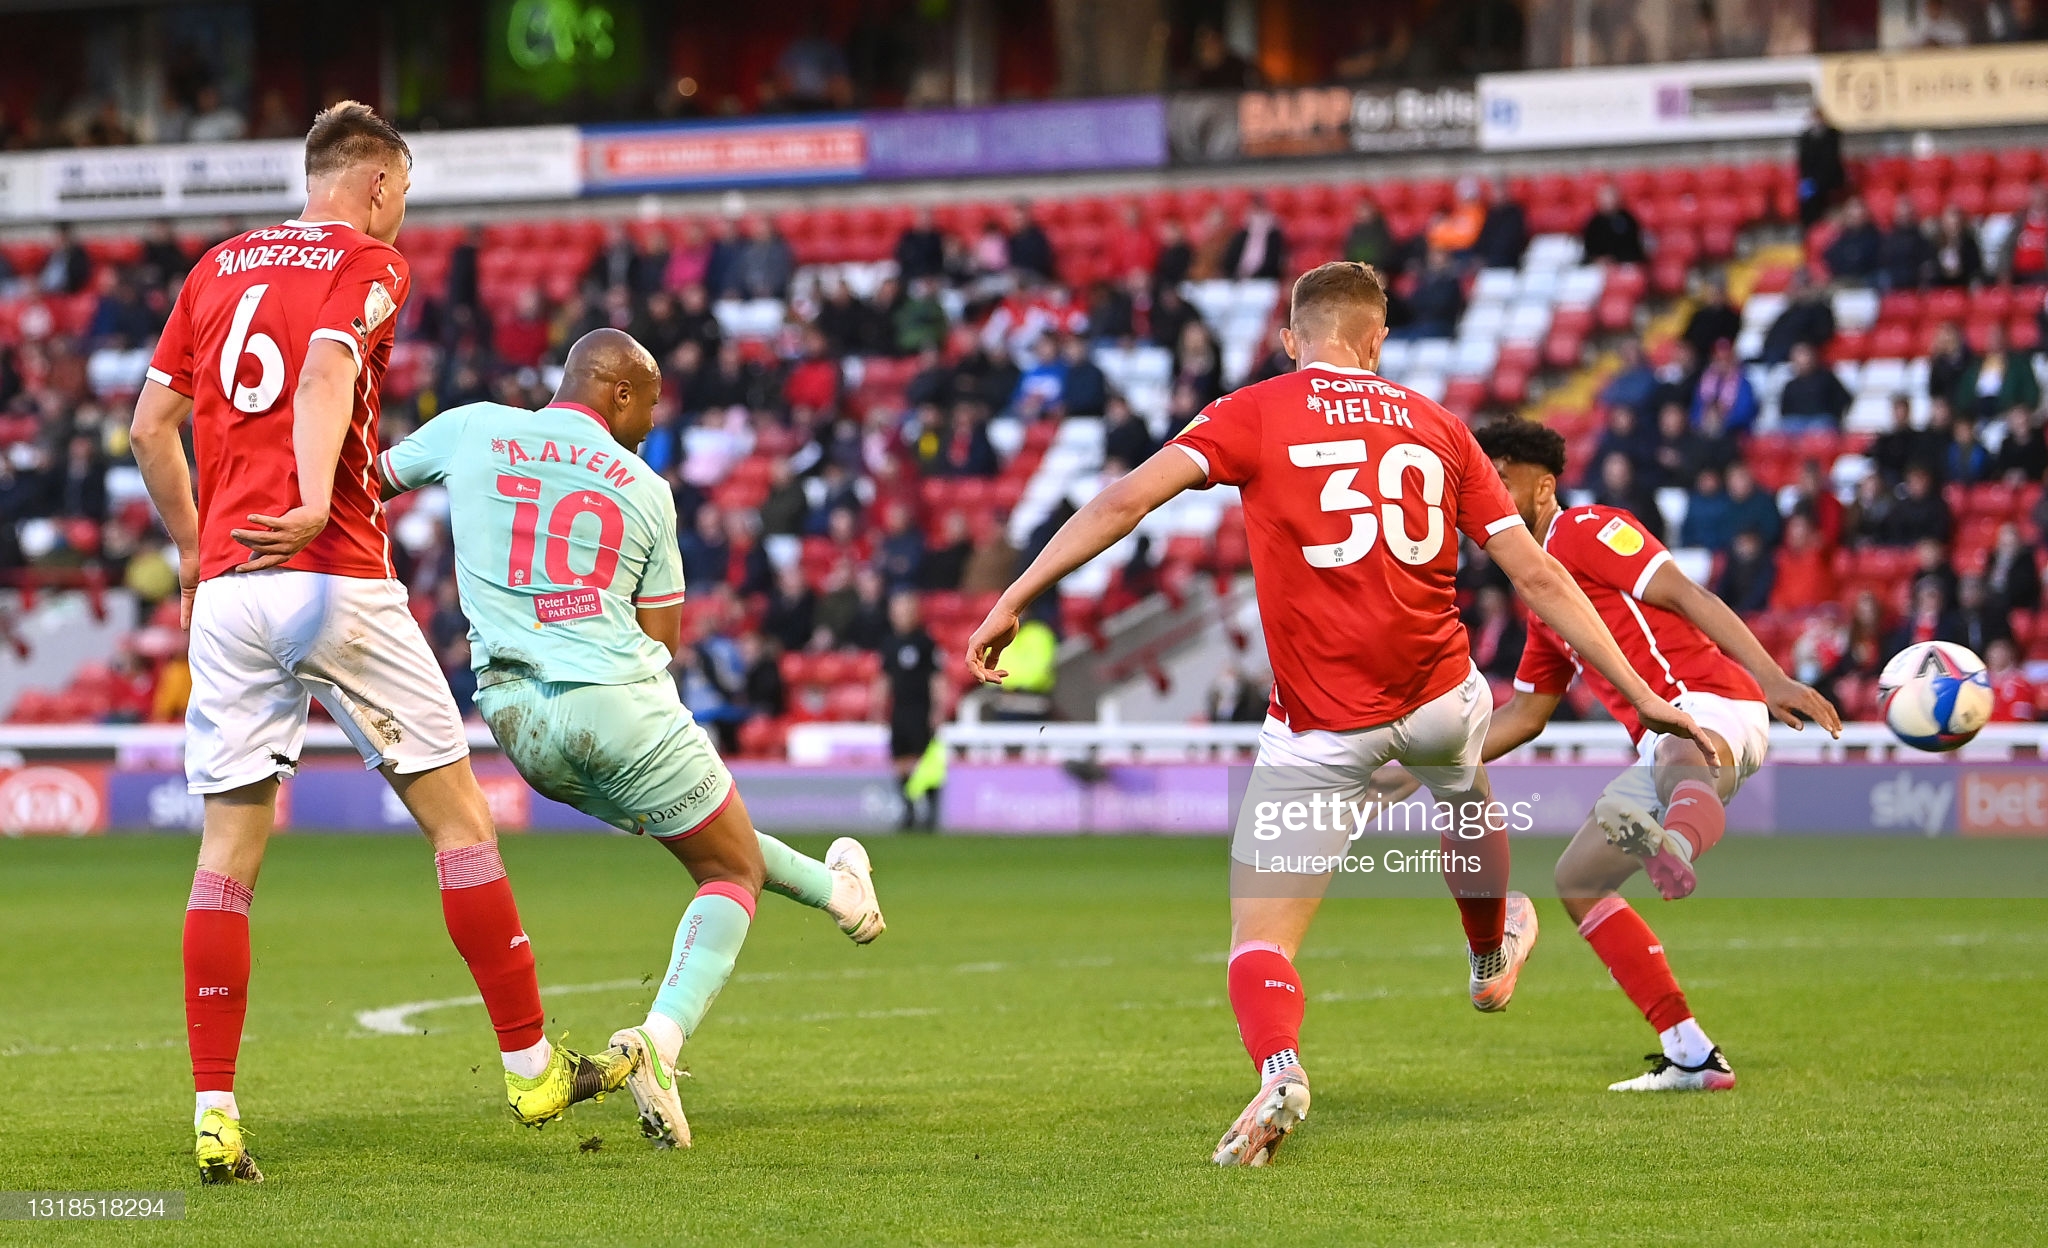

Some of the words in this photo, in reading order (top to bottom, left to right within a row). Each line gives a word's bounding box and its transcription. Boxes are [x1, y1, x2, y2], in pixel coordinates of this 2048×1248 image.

[245, 228, 333, 243] palmer
[216, 244, 345, 278] ANDERSEN
[219, 283, 286, 413] 6
[1310, 378, 1408, 400] palmer
[1322, 397, 1414, 429] HELIK
[1287, 438, 1445, 569] 30
[495, 474, 626, 591] 10
[537, 596, 565, 610] Peter
[566, 592, 595, 612] Lynn
[548, 603, 597, 618] PARTNERS
[648, 770, 718, 825] Dawsons
[1868, 770, 1955, 839] sky
[1965, 772, 2048, 829] bet
[198, 987, 229, 997] BFC
[1264, 979, 1296, 993] BFC
